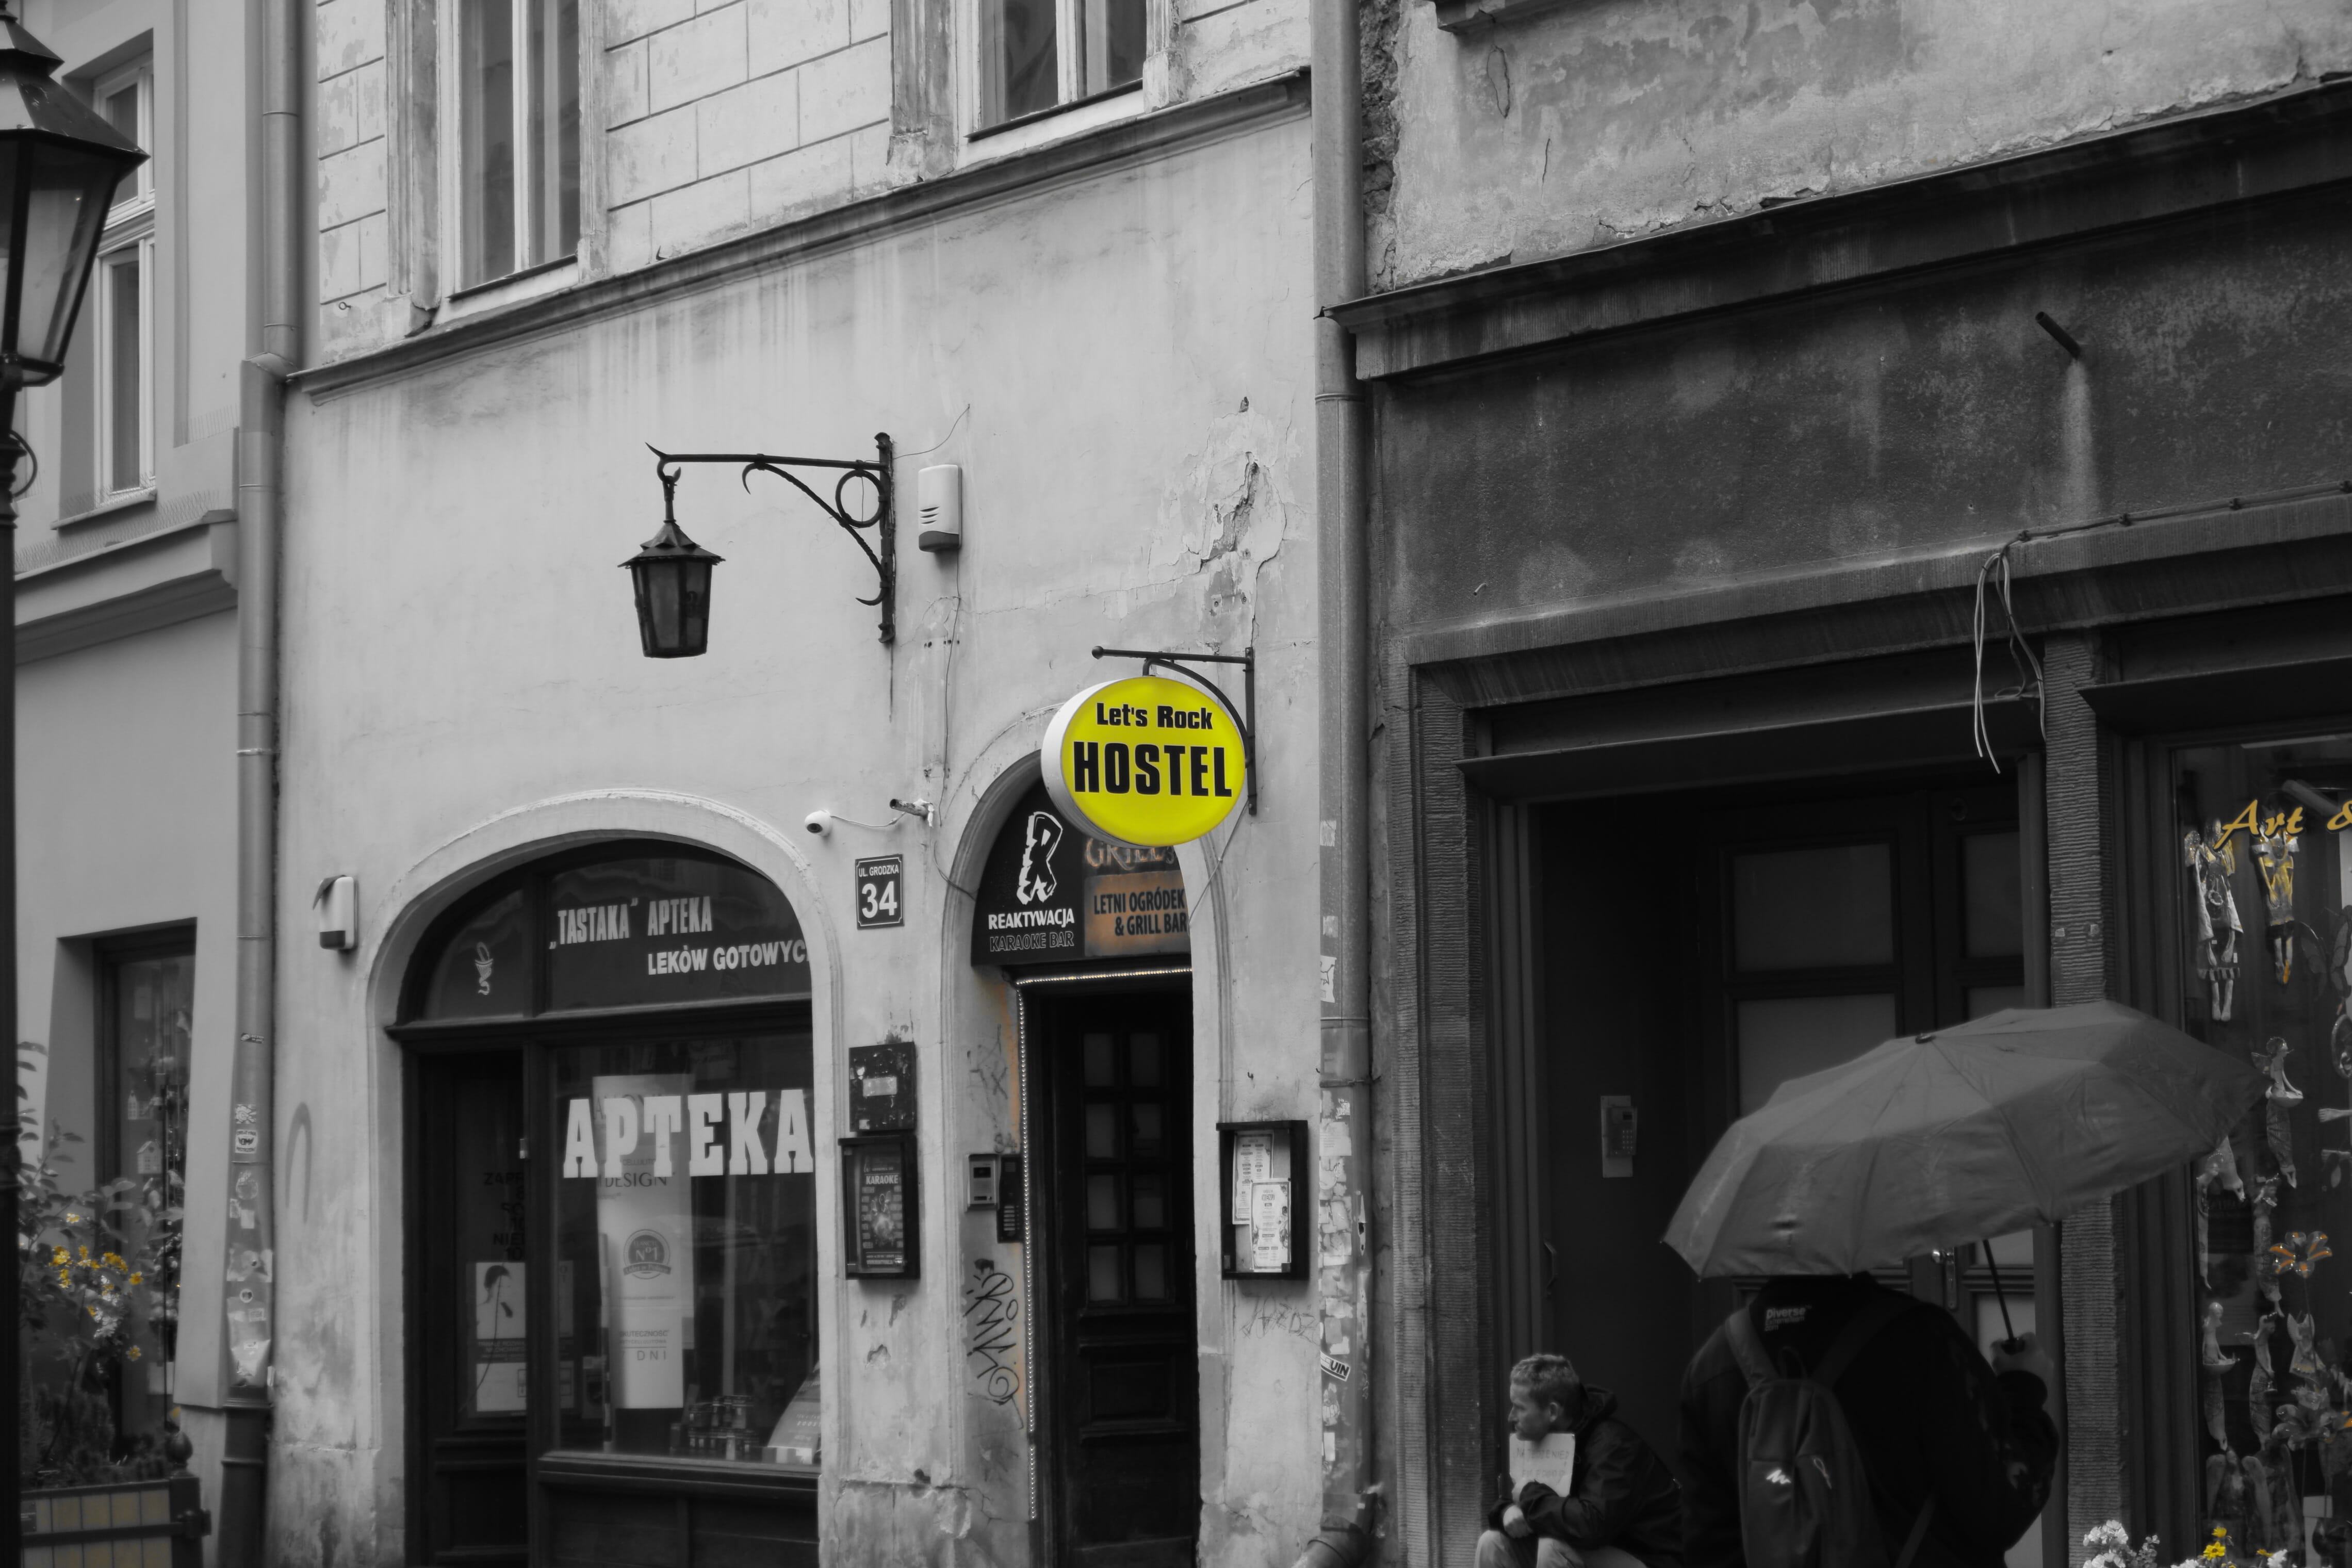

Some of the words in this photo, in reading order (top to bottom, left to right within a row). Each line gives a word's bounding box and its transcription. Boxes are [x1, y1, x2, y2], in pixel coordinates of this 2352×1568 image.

[1097, 703, 1148, 727] Let's
[1157, 705, 1213, 730] Rock
[1073, 741, 1232, 797] HOSTEL
[2213, 799, 2304, 850] Art
[858, 868, 868, 877] UL.
[869, 864, 899, 876] GRODZKA
[861, 880, 897, 918] 34
[1094, 893, 1126, 914] LETNI
[1129, 886, 1185, 912] OGRÓDEK
[647, 896, 713, 936] APTEKA
[988, 908, 1075, 929] REAKTYWACJA
[1115, 916, 1124, 936] &
[1127, 913, 1162, 936] GRILL
[1164, 912, 1187, 933] BAR
[990, 933, 1047, 952] KARAOKE
[1050, 931, 1074, 948] BAR
[648, 944, 708, 975] LEKÓW
[713, 939, 809, 971] GOTOWYC
[563, 1089, 814, 1179] APTEKA
[866, 1174, 899, 1185] KARAOKE
[637, 1350, 666, 1361] DNI
